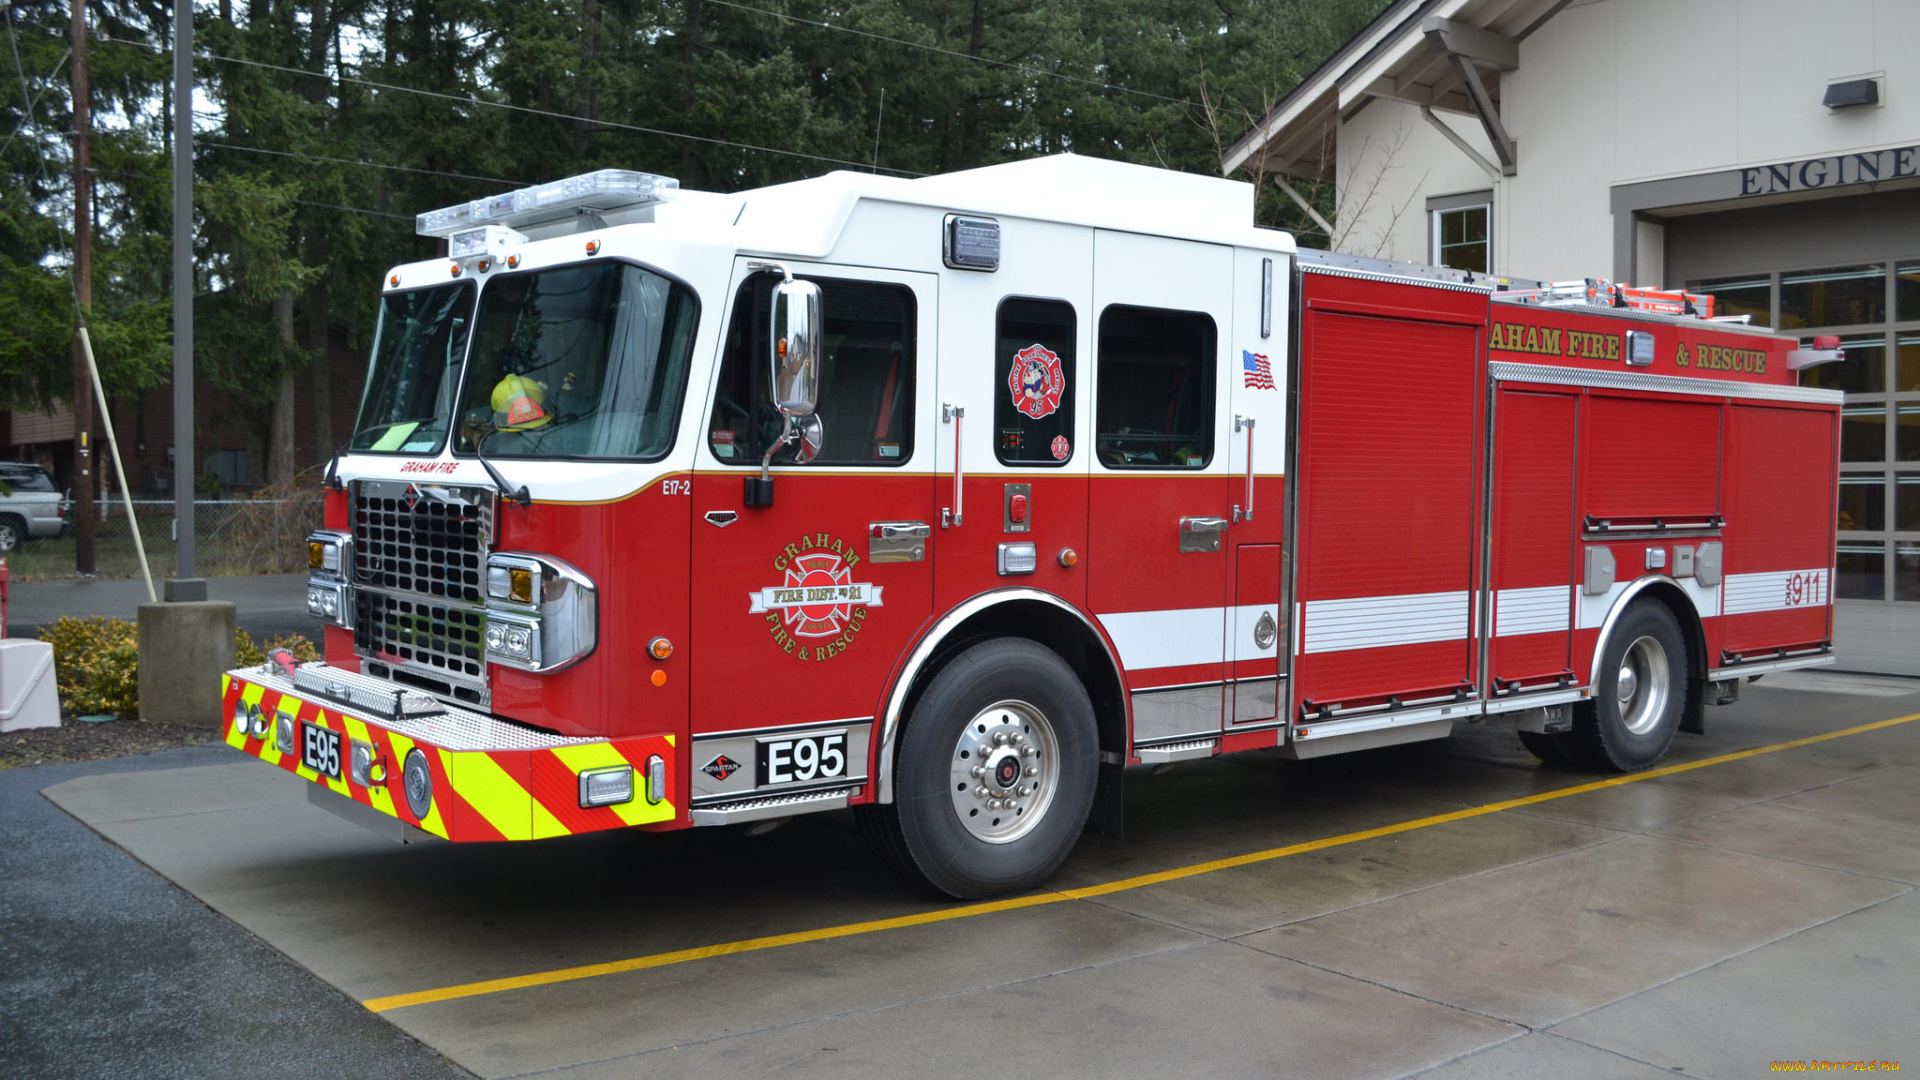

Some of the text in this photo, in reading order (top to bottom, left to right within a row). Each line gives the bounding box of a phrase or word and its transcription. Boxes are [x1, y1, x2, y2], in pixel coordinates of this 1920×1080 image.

[1738, 147, 1917, 197] ENGINE
[1567, 331, 1620, 361] FIRE
[1675, 342, 1767, 375] & RESCUE
[1030, 400, 1044, 414] 95
[400, 461, 460, 474] GRAHAM FIRE
[663, 480, 690, 495] E17-2
[774, 533, 861, 572] GRAHAM
[806, 560, 831, 569] PIERCE
[773, 589, 804, 603] FIRE
[807, 588, 838, 602] DIST.
[849, 586, 862, 600] 21
[1792, 571, 1819, 606] 911
[765, 607, 867, 661] FIRE & RESCUE
[803, 622, 832, 632] COUNTY
[306, 725, 339, 776] E95
[769, 735, 845, 784] E95
[705, 763, 739, 773] SPARTAN
